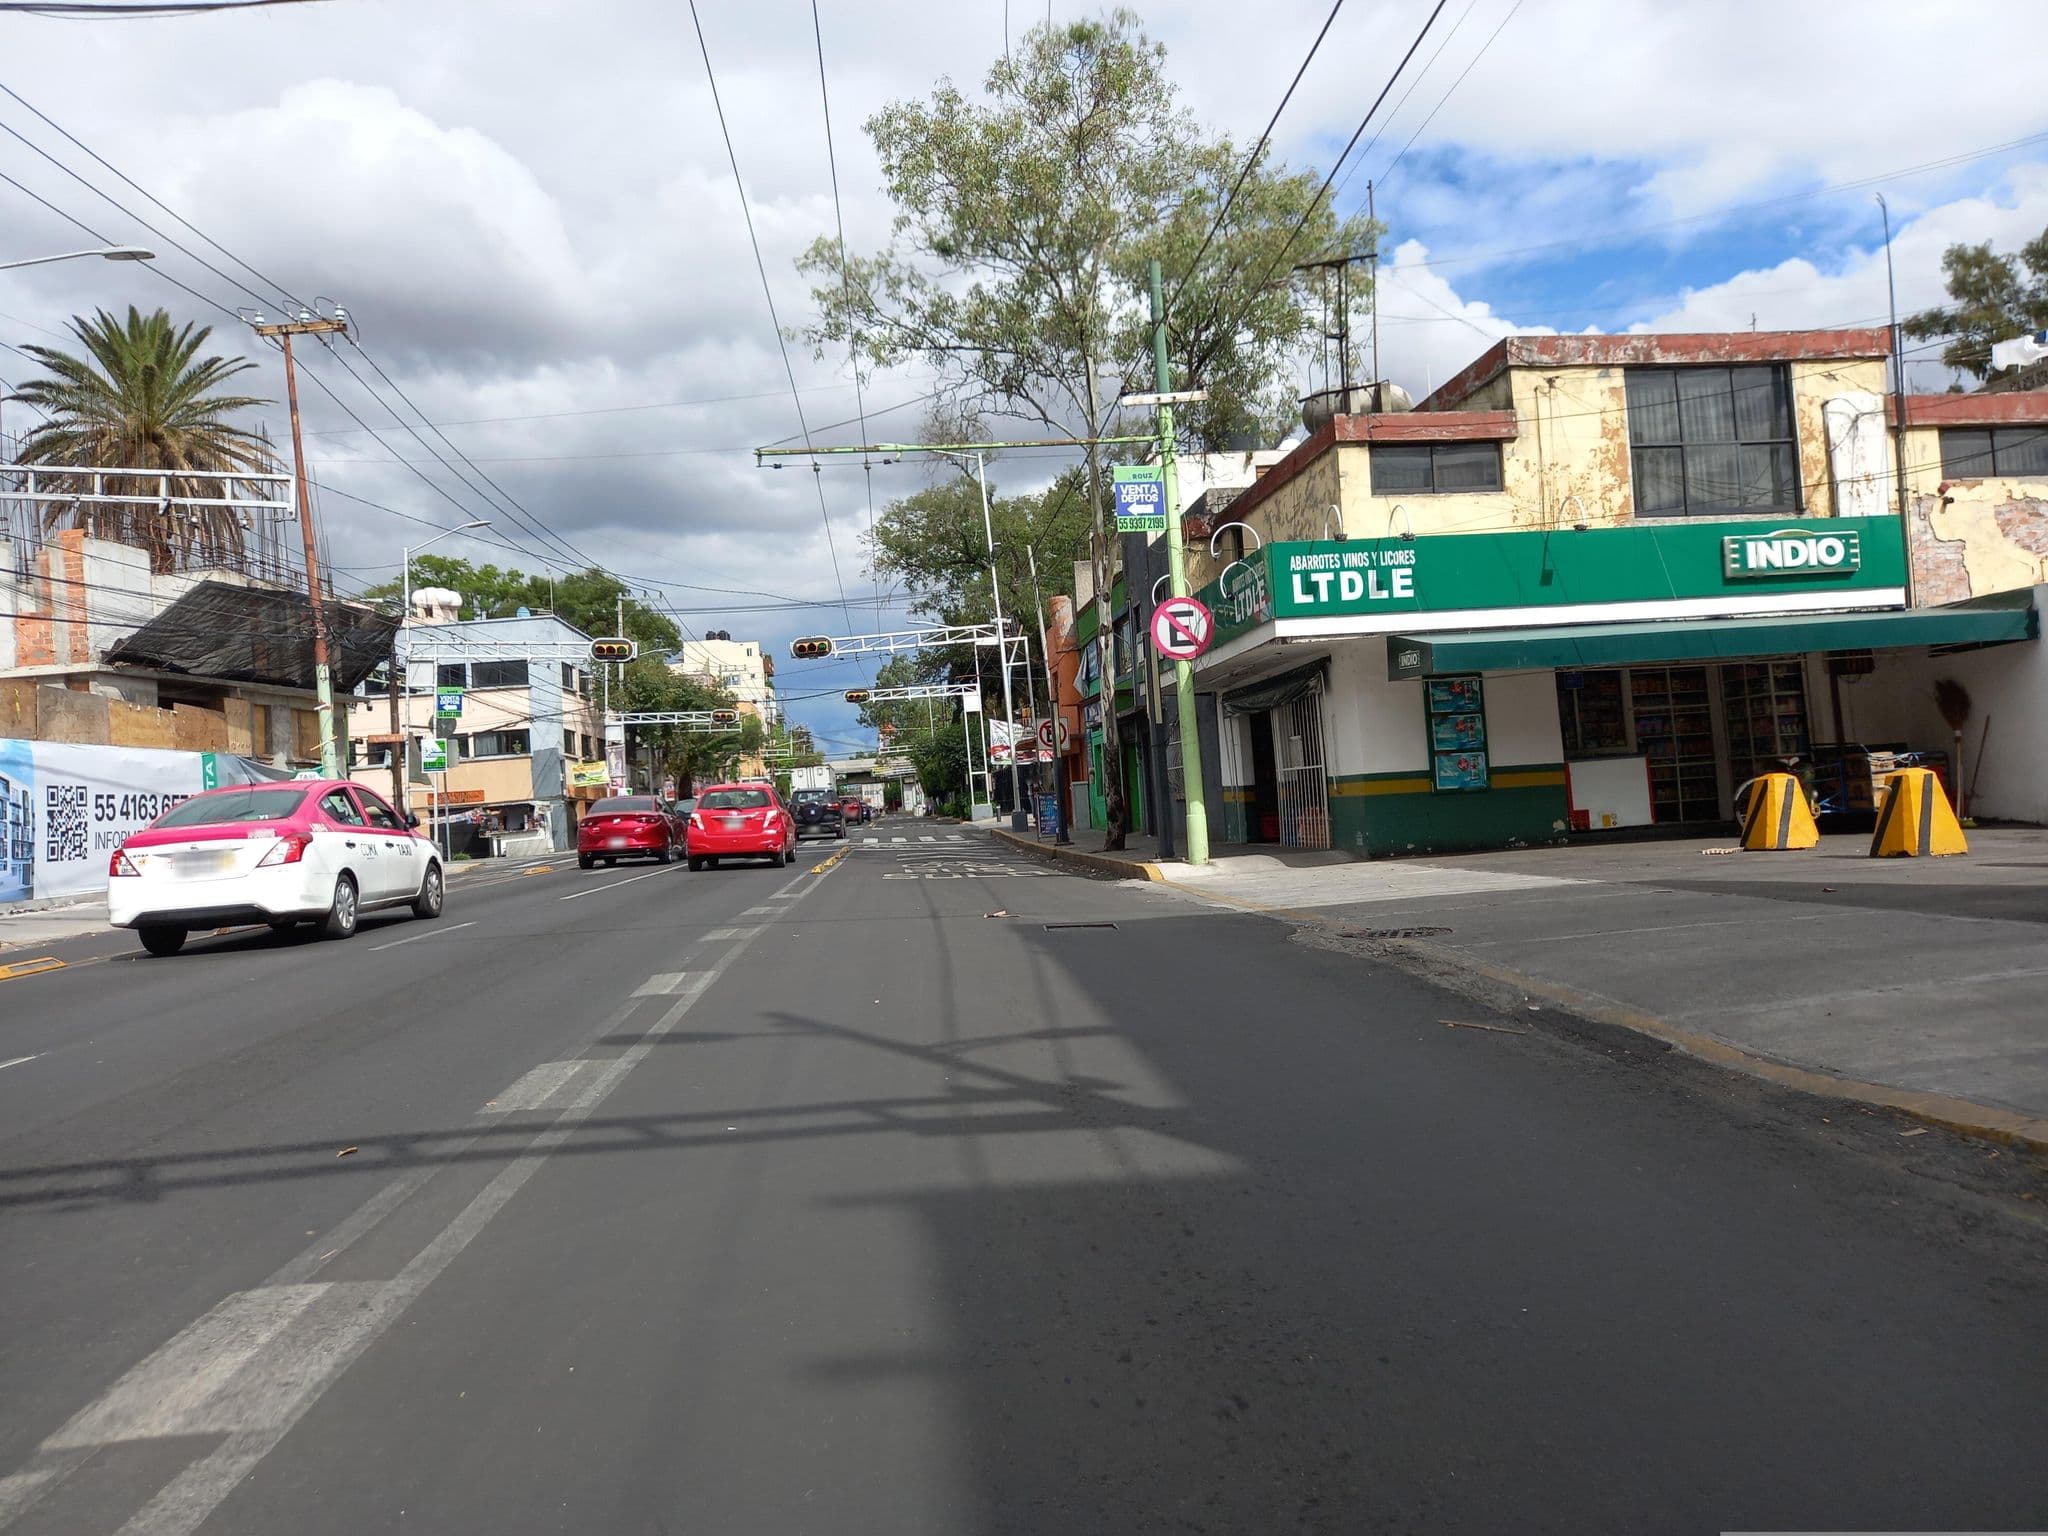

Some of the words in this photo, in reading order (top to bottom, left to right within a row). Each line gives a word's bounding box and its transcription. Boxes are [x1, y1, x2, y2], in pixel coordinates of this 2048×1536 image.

[1120, 484, 1158, 495] VENTA
[1121, 494, 1159, 503] DEPTOS
[1119, 518, 1128, 529] 55
[1746, 537, 1845, 569] INDIO
[1290, 553, 1341, 571] ABARROTES
[1342, 552, 1369, 568] VINOS
[1372, 551, 1378, 566] Y
[1380, 549, 1416, 566] LICORES
[94, 794, 116, 822] 55
[119, 793, 158, 821] 4163
[396, 843, 412, 856] TAXI
